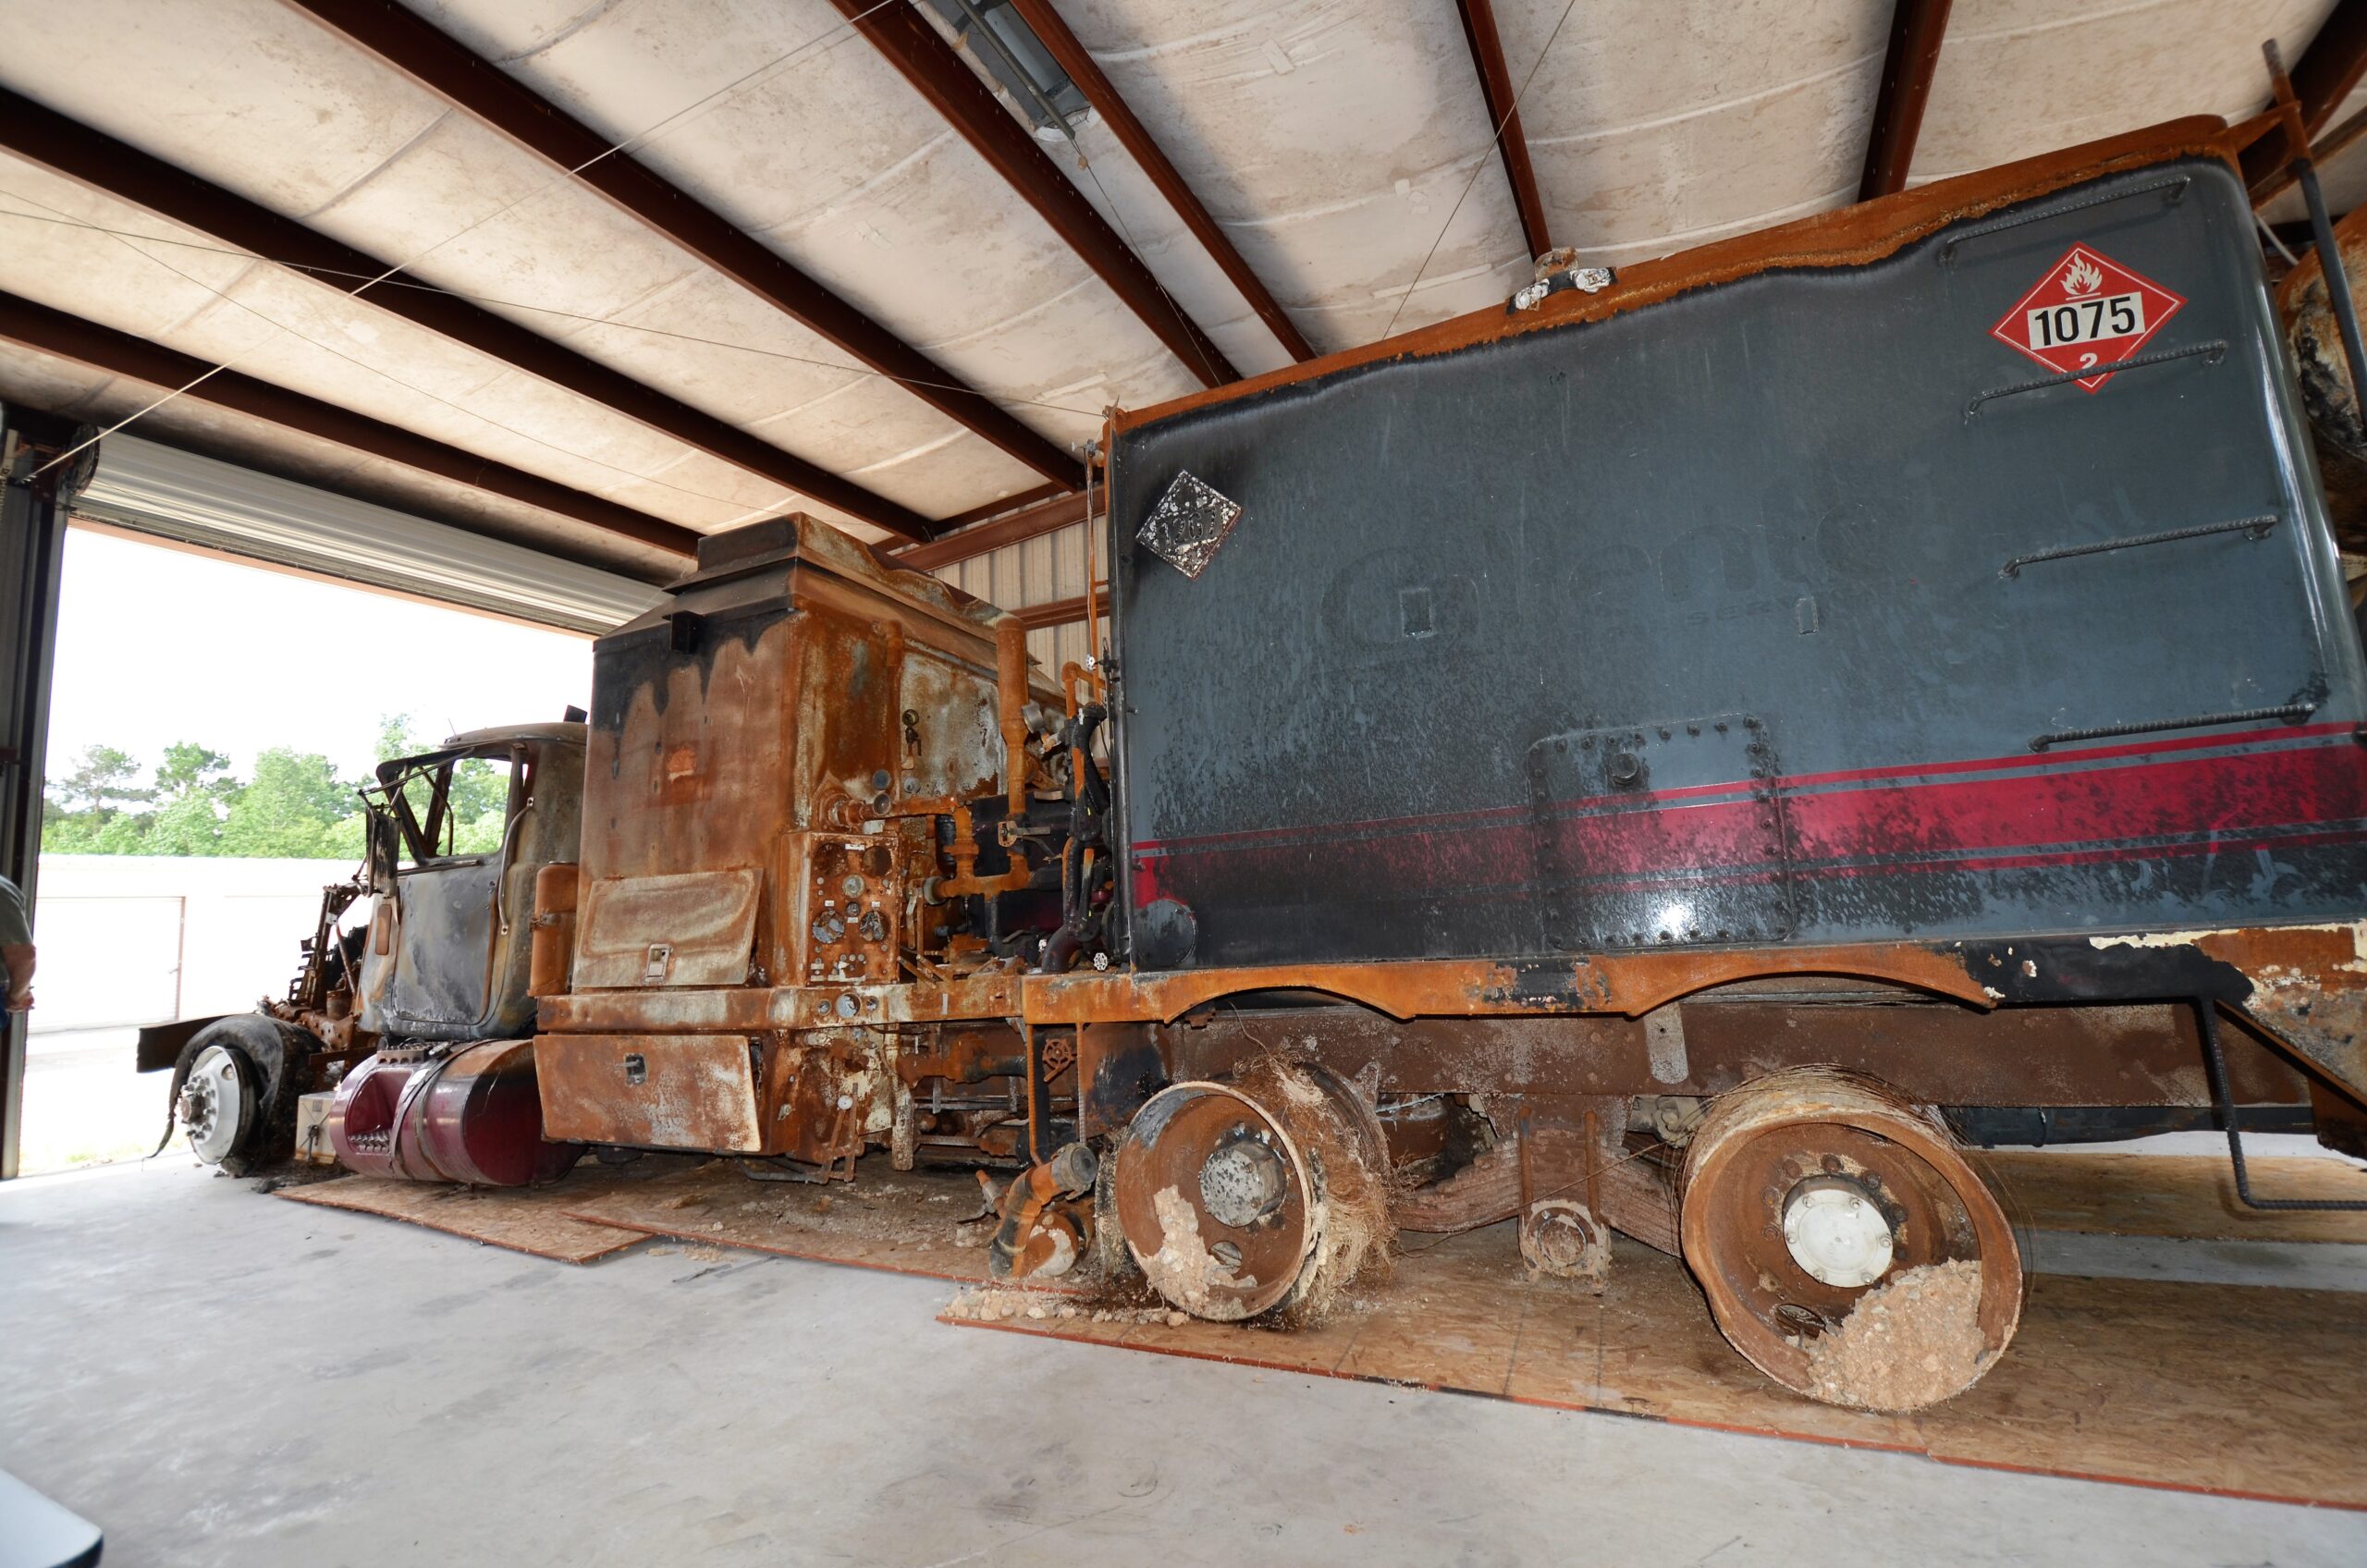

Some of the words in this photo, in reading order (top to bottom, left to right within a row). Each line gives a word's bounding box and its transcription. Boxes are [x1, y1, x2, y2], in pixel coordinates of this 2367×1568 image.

[2034, 296, 2136, 346] 1075
[2079, 352, 2098, 370] 2
[1159, 507, 1218, 551] 1267
